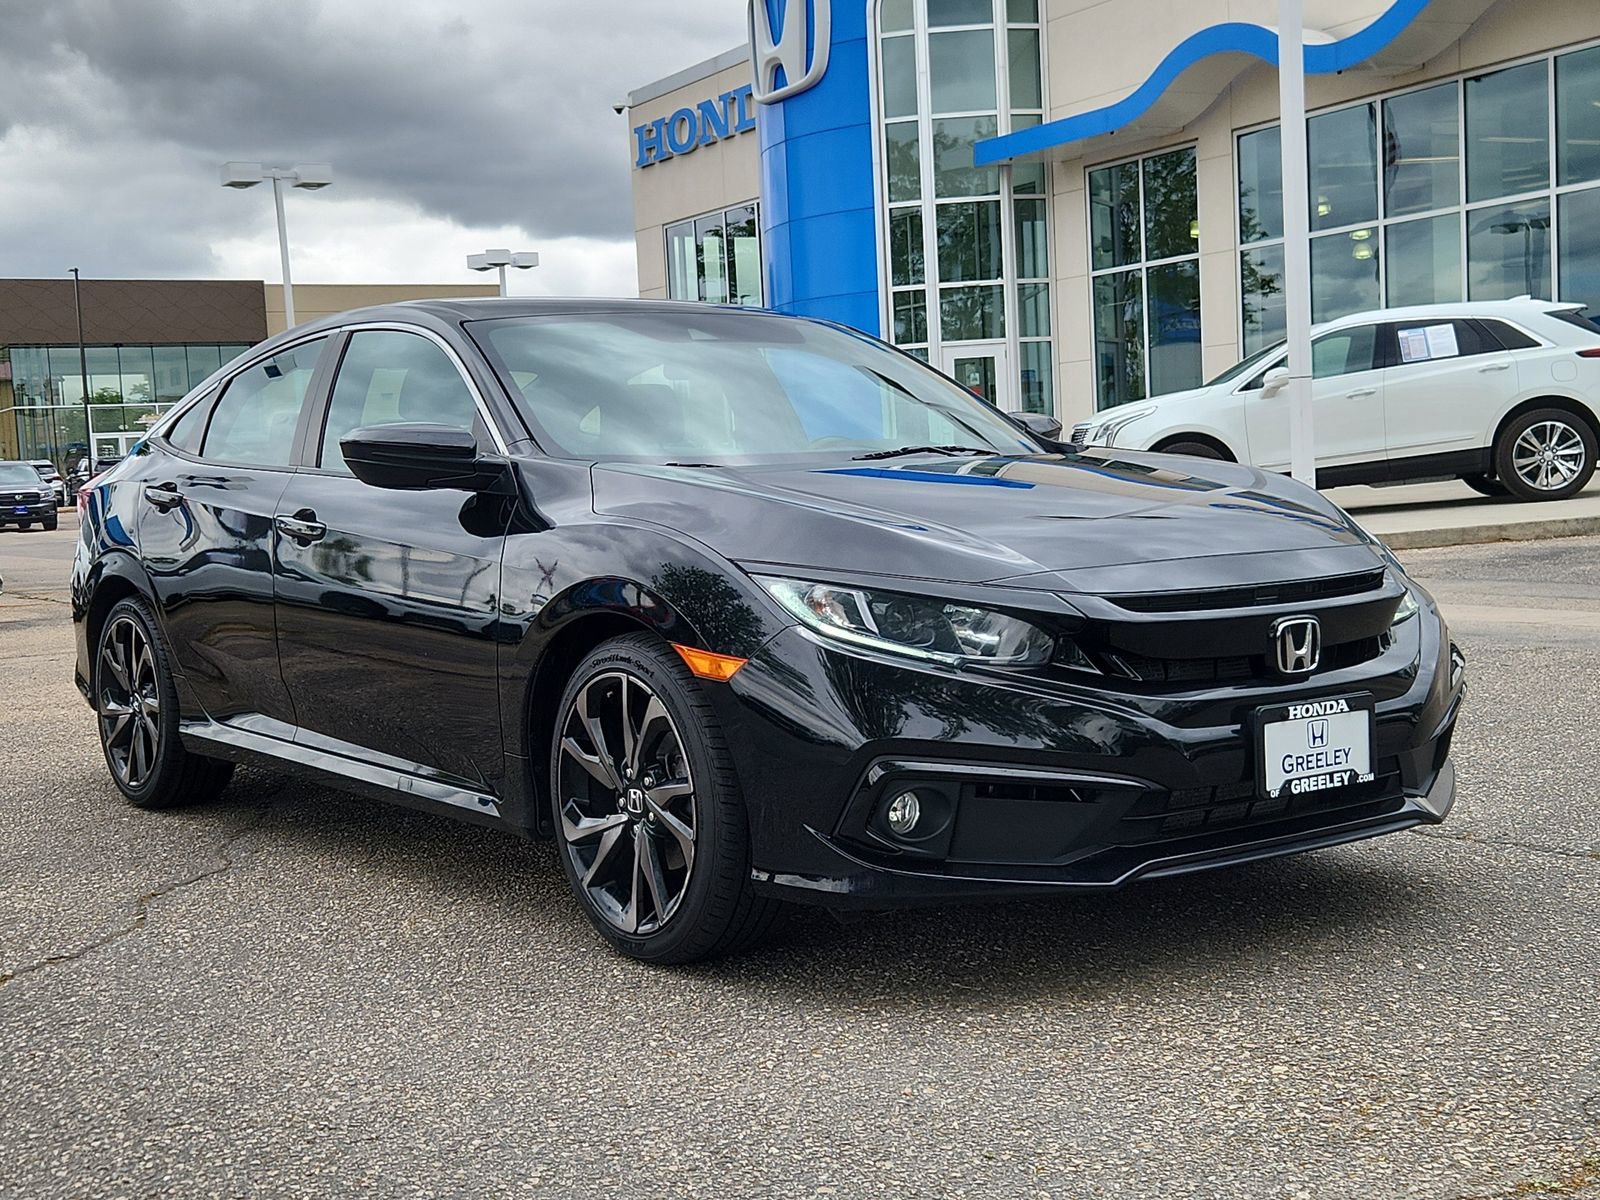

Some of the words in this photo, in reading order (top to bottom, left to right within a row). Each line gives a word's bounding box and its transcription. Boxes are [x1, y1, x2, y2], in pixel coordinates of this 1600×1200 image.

[1288, 699, 1350, 719] HONDA
[1282, 747, 1352, 774] GREELEY
[1270, 789, 1280, 798] OF
[1291, 771, 1351, 794] GREELEY
